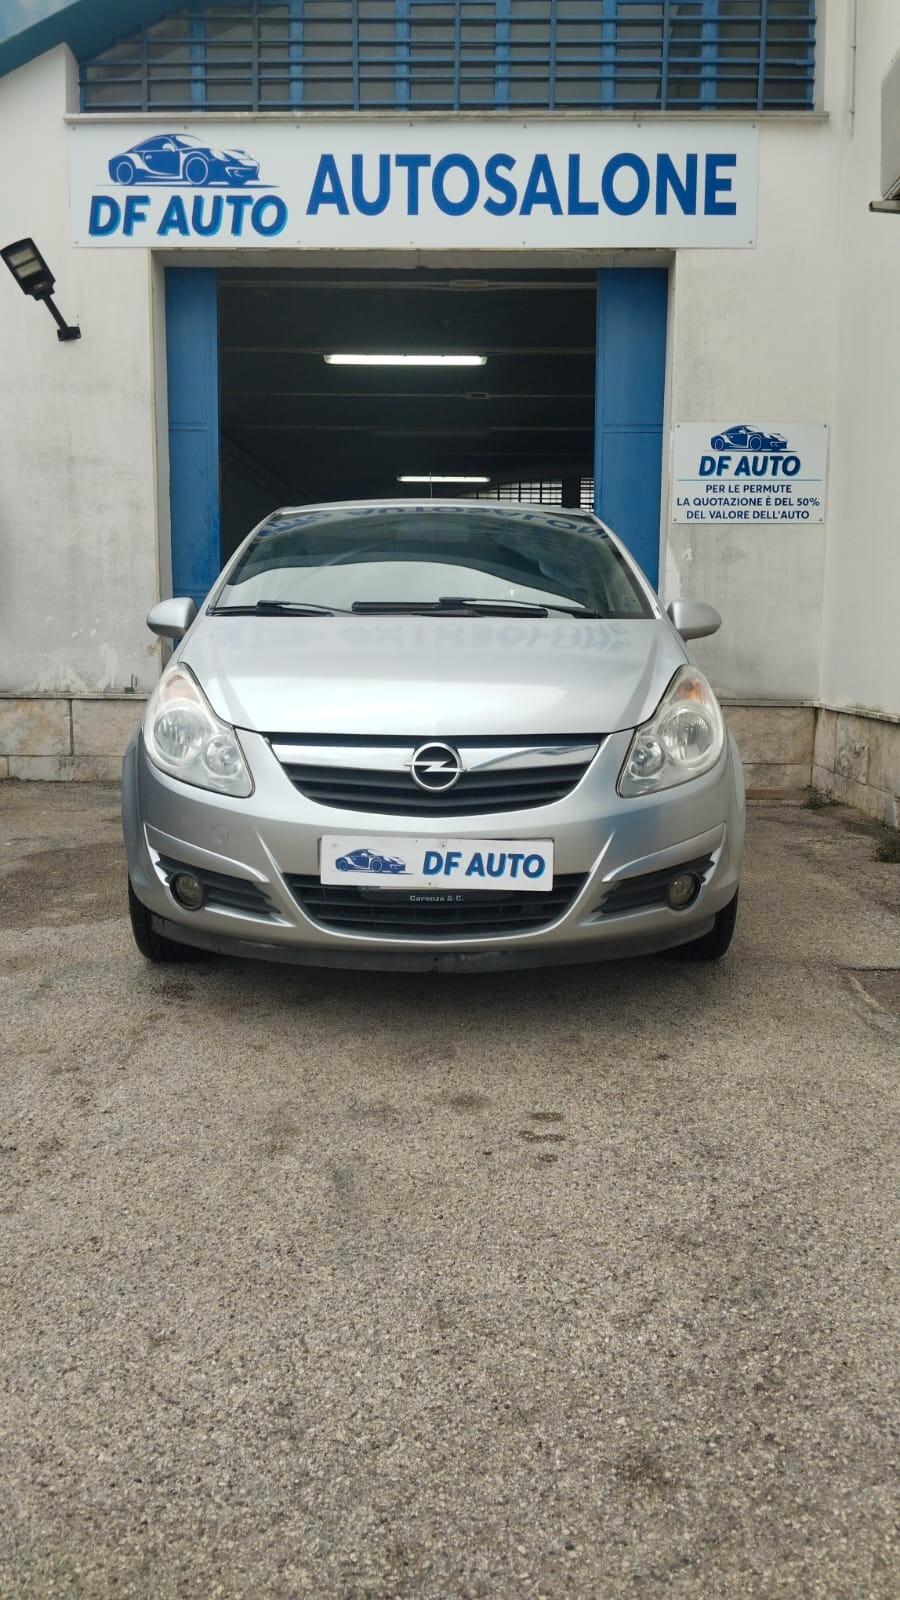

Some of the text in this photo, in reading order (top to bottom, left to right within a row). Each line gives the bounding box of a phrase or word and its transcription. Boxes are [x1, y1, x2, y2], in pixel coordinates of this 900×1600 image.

[306, 152, 737, 216] AUTOSALONE
[88, 195, 288, 237] DF AUTO
[698, 455, 801, 477] DF AUTO
[706, 484, 792, 493] PER LE PERMUTE
[676, 495, 821, 507] LA QUOTAZIONE È DEL 50%
[686, 510, 810, 520] DEL VALORE DELL'AUTO
[422, 850, 546, 879] DF AUTO
